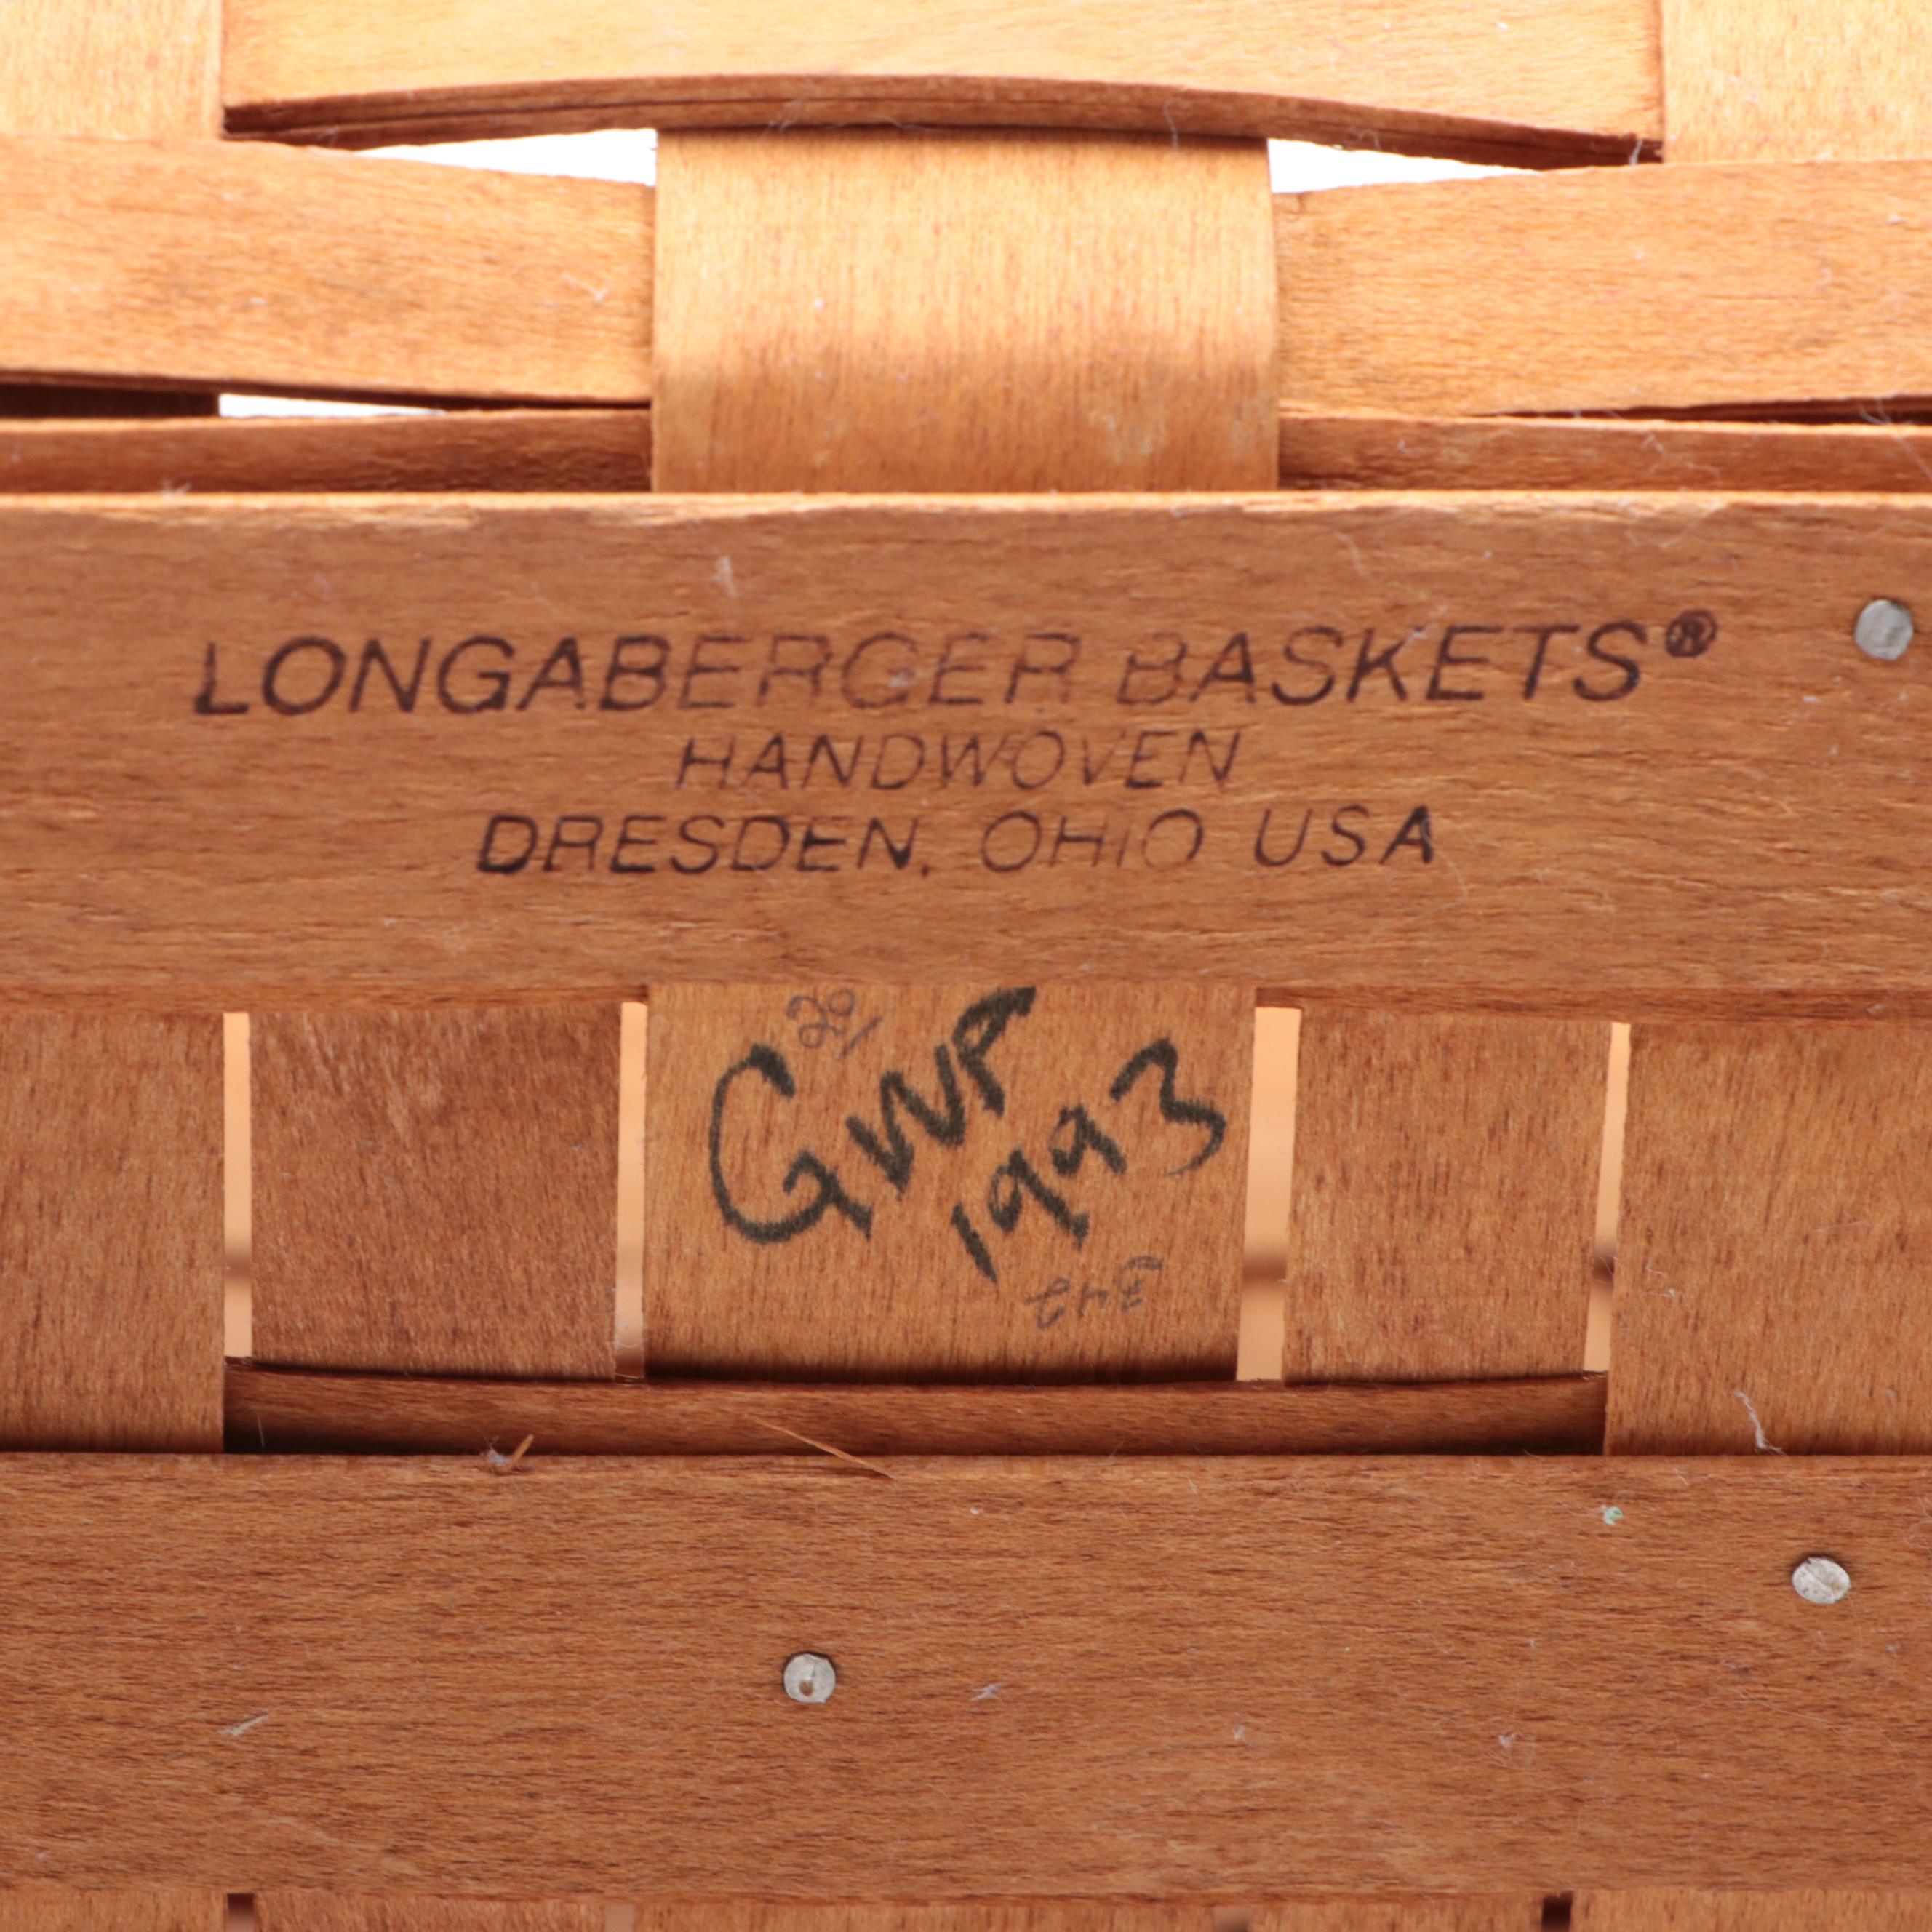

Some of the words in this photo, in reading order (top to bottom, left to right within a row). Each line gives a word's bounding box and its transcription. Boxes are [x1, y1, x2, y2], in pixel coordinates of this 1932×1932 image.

[193, 632, 1082, 716] LONGABERGER
[675, 729, 1241, 791] HANDWOVEN
[979, 808, 1205, 873] OHIO
[1251, 804, 1435, 868] USA
[952, 1036, 1227, 1285] 1993
